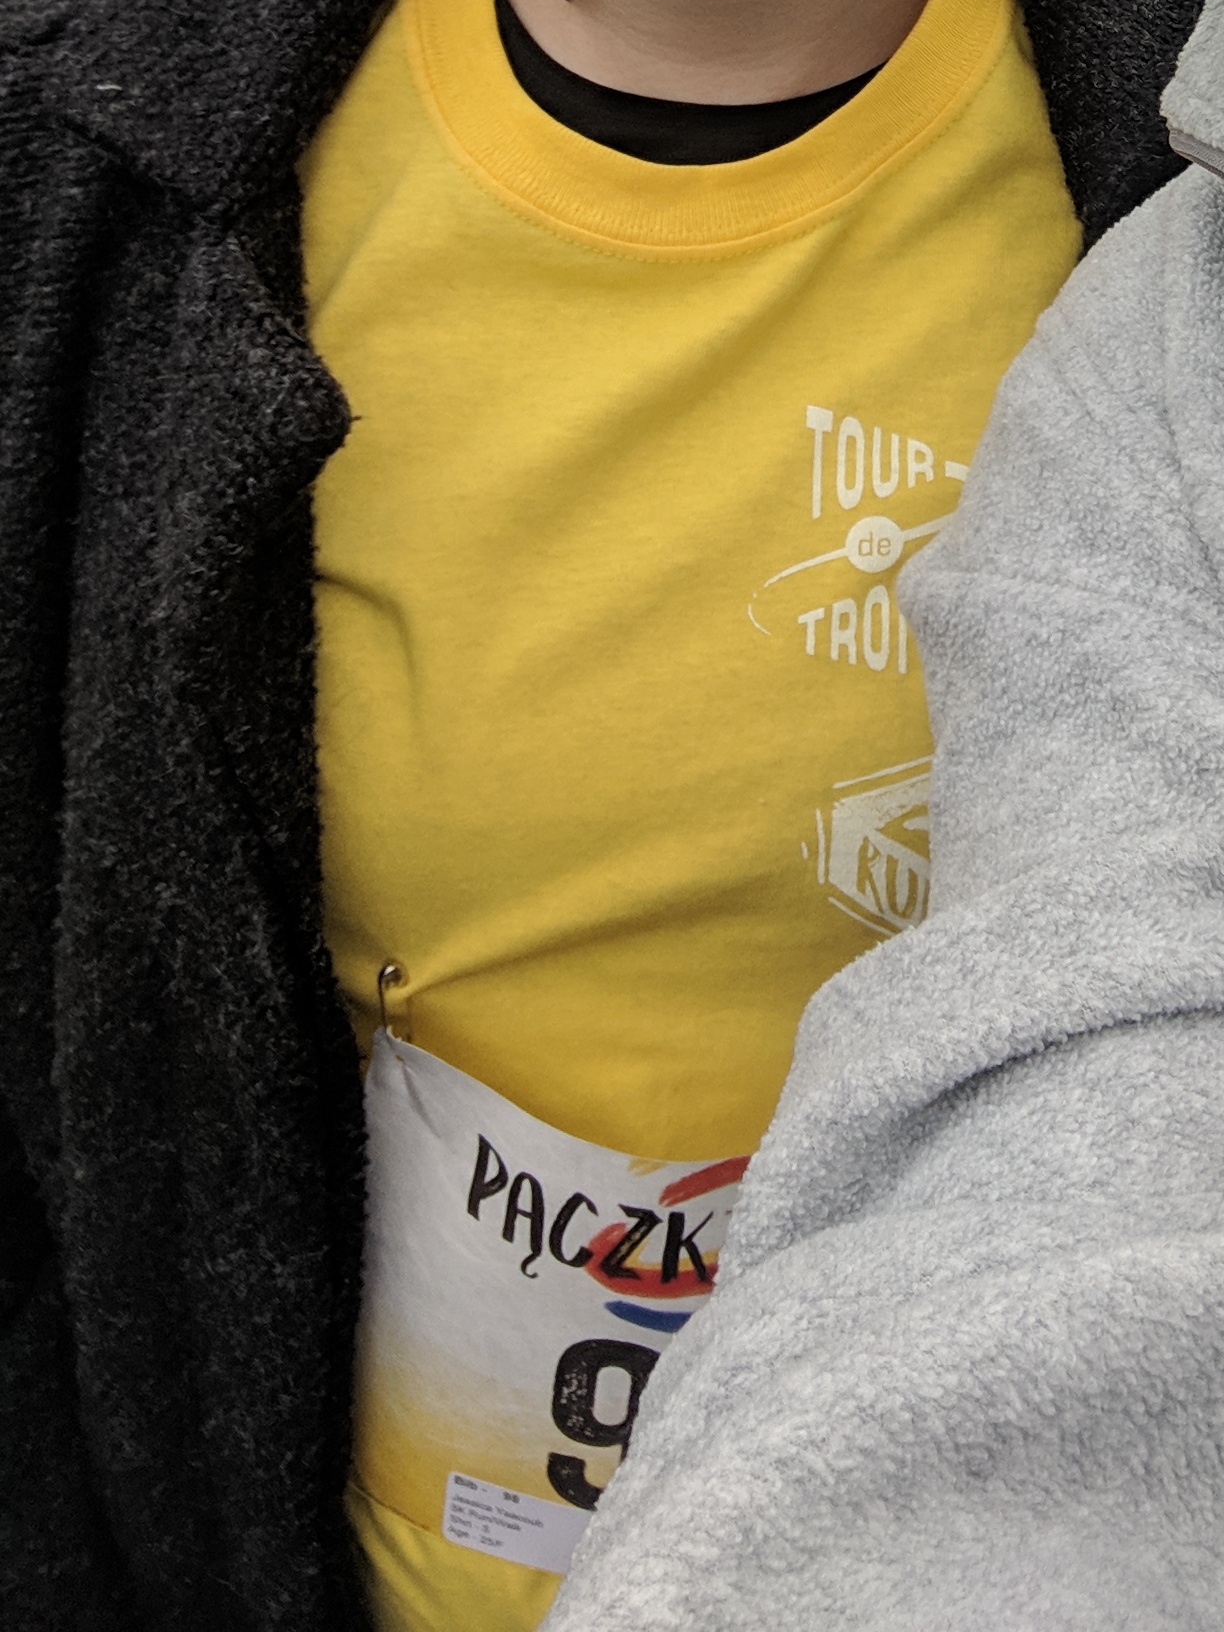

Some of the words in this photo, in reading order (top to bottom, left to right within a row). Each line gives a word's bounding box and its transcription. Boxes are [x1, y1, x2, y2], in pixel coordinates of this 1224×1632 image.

[806, 405, 934, 519] TOUR
[858, 531, 891, 556] de
[797, 585, 908, 675] TROI
[856, 835, 930, 922] RU
[467, 1133, 732, 1285] PĄCZK
[547, 1339, 661, 1511] 9
